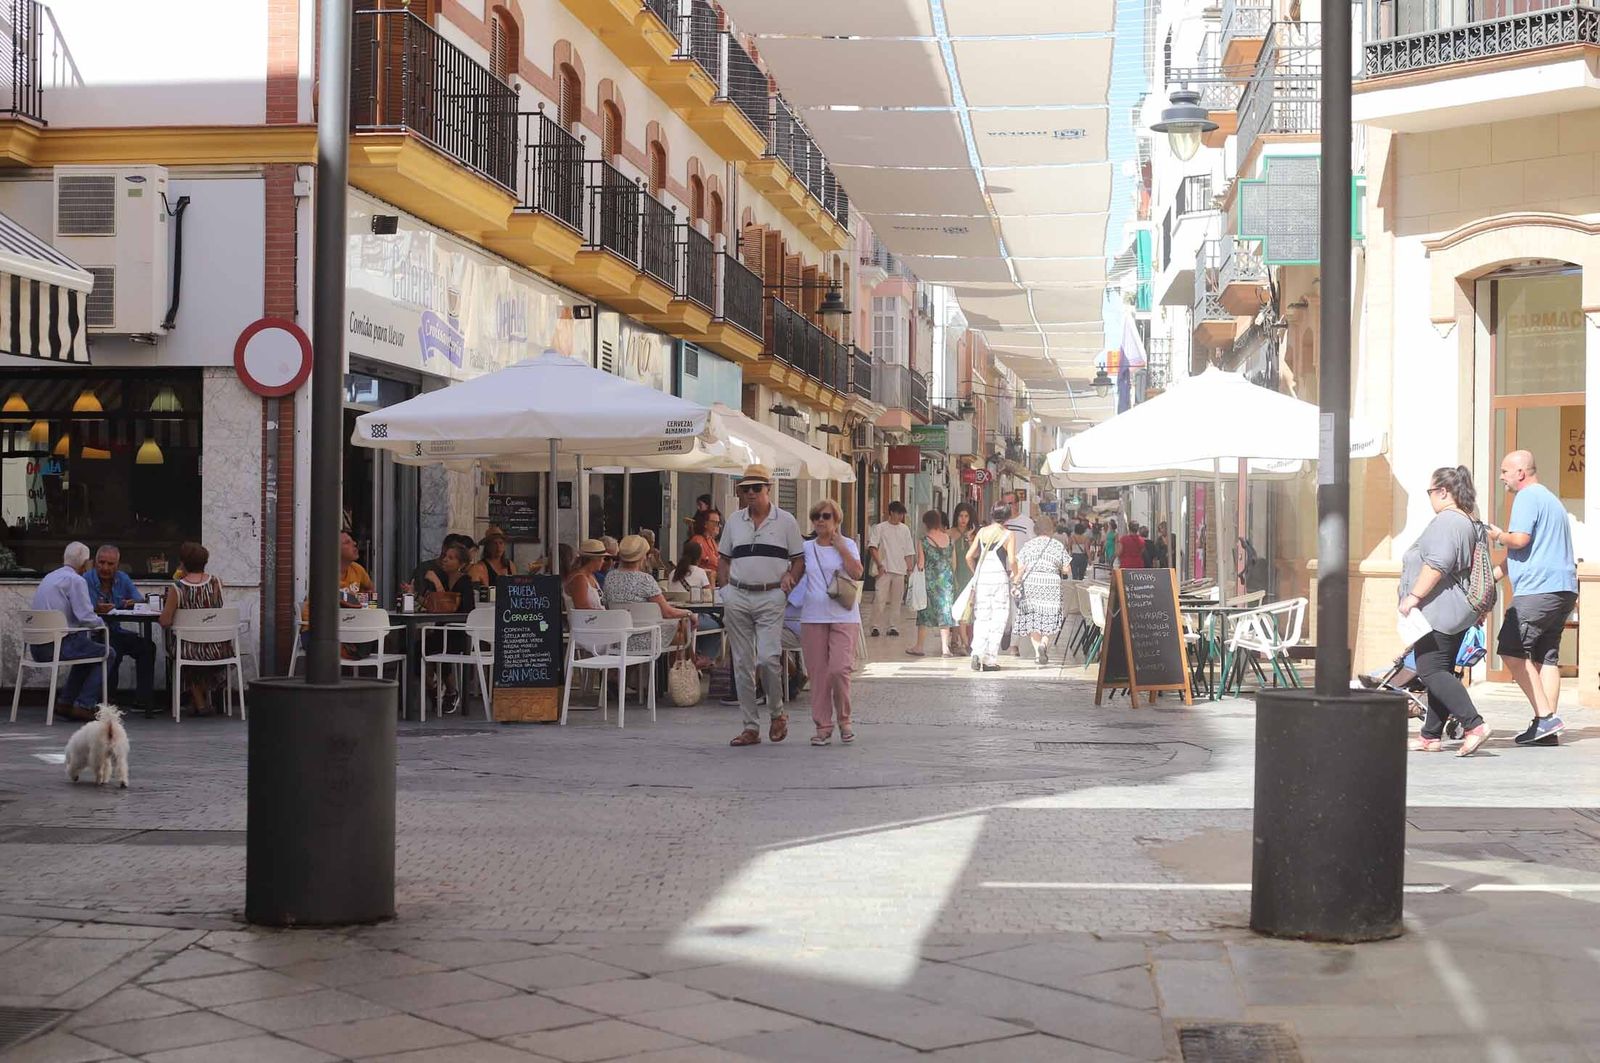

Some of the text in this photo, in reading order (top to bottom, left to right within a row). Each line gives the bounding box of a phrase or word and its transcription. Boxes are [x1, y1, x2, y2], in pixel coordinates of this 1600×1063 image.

[374, 323, 388, 343] para
[388, 324, 405, 347] llevar
[667, 420, 694, 428] CERVEZAS
[1129, 571, 1156, 582] TARTAS
[508, 585, 537, 597] PRUEBA
[510, 597, 550, 609] NUESTRAS
[502, 668, 520, 682] SAN
